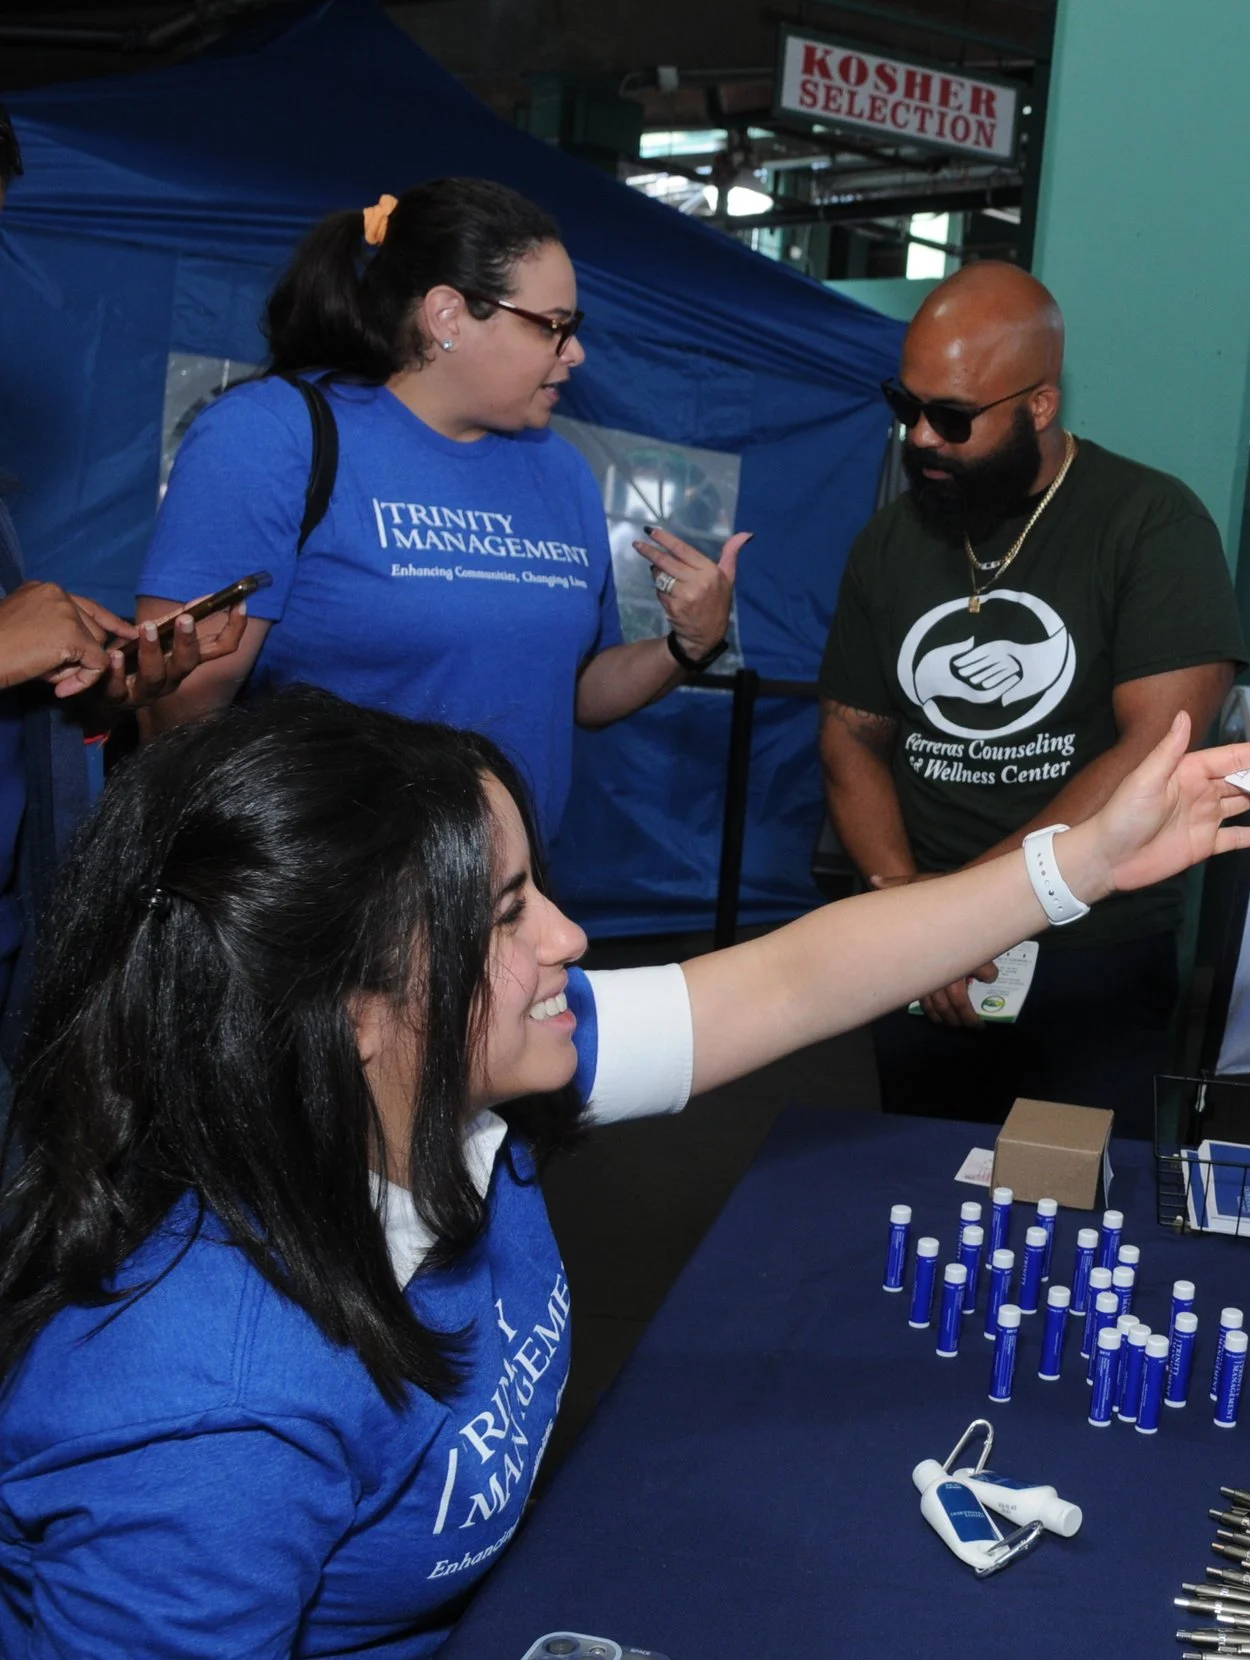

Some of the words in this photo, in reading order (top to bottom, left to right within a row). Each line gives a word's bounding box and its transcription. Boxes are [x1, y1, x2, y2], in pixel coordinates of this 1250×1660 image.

[802, 43, 997, 119] KOSHER
[799, 78, 996, 149] SELECTION
[379, 501, 514, 535] TRINITY
[391, 527, 590, 567] MANAGEMENT
[391, 563, 453, 581] Enhancing
[454, 565, 521, 583] Communities,
[522, 571, 570, 589] Changing
[905, 732, 965, 758] Ferreras
[967, 732, 1076, 761] Counseling
[923, 757, 996, 785] Wellness
[1000, 759, 1072, 784] Center
[1174, 1338, 1183, 1377] TRINITY
[1226, 1360, 1240, 1420] MANAGEMENT
